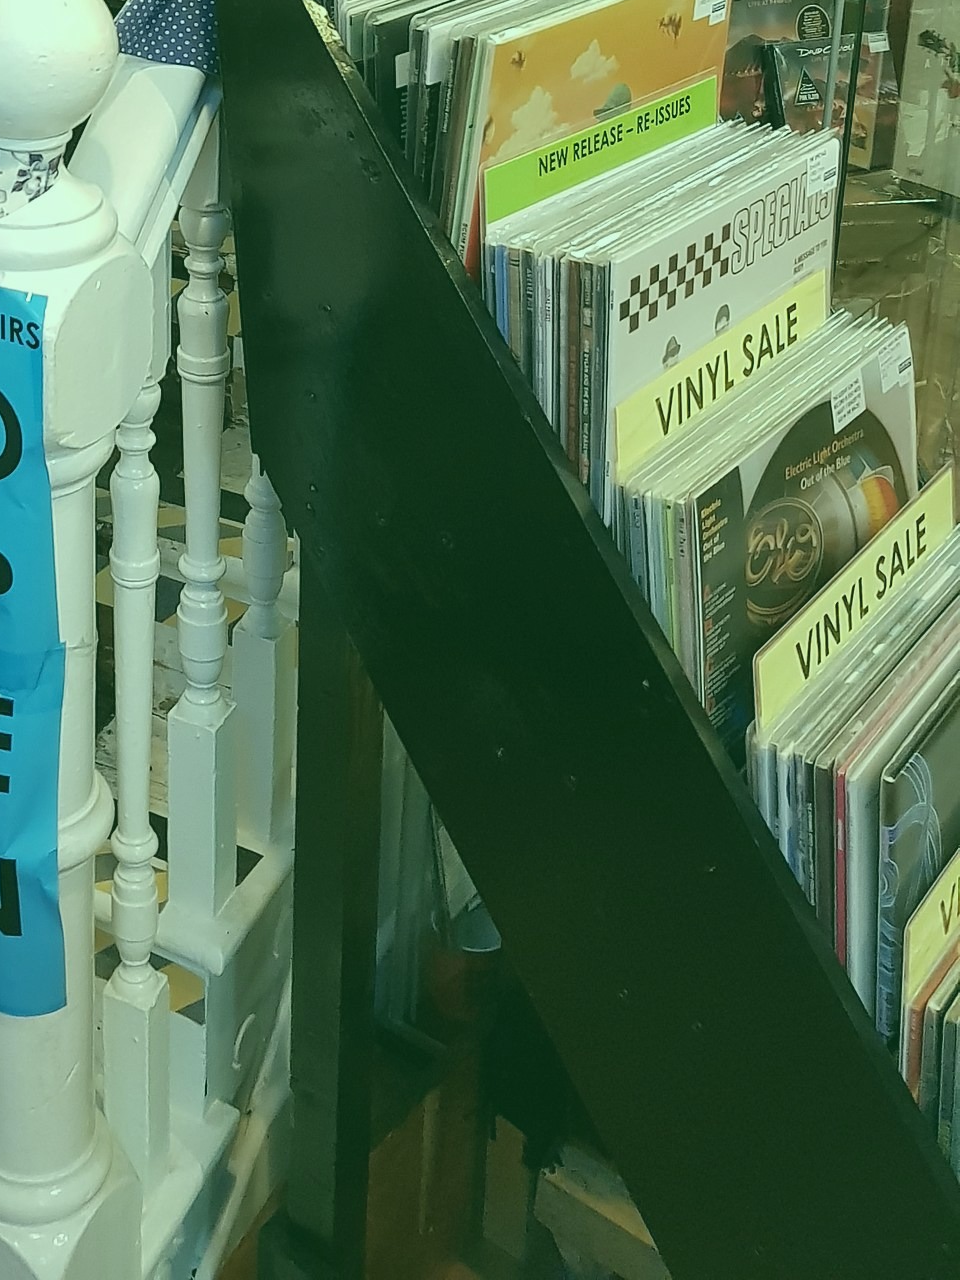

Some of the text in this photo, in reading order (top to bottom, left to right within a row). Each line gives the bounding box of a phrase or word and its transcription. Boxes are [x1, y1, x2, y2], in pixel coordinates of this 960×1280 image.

[538, 93, 693, 178] NEW RELEASE RE-ISSUES
[654, 349, 736, 437] VINYL
[740, 301, 799, 378] SALE
[785, 428, 865, 481] Electric Light Orchestra
[800, 454, 851, 491] Out of the Blue
[794, 512, 929, 682] VINYL SALE
